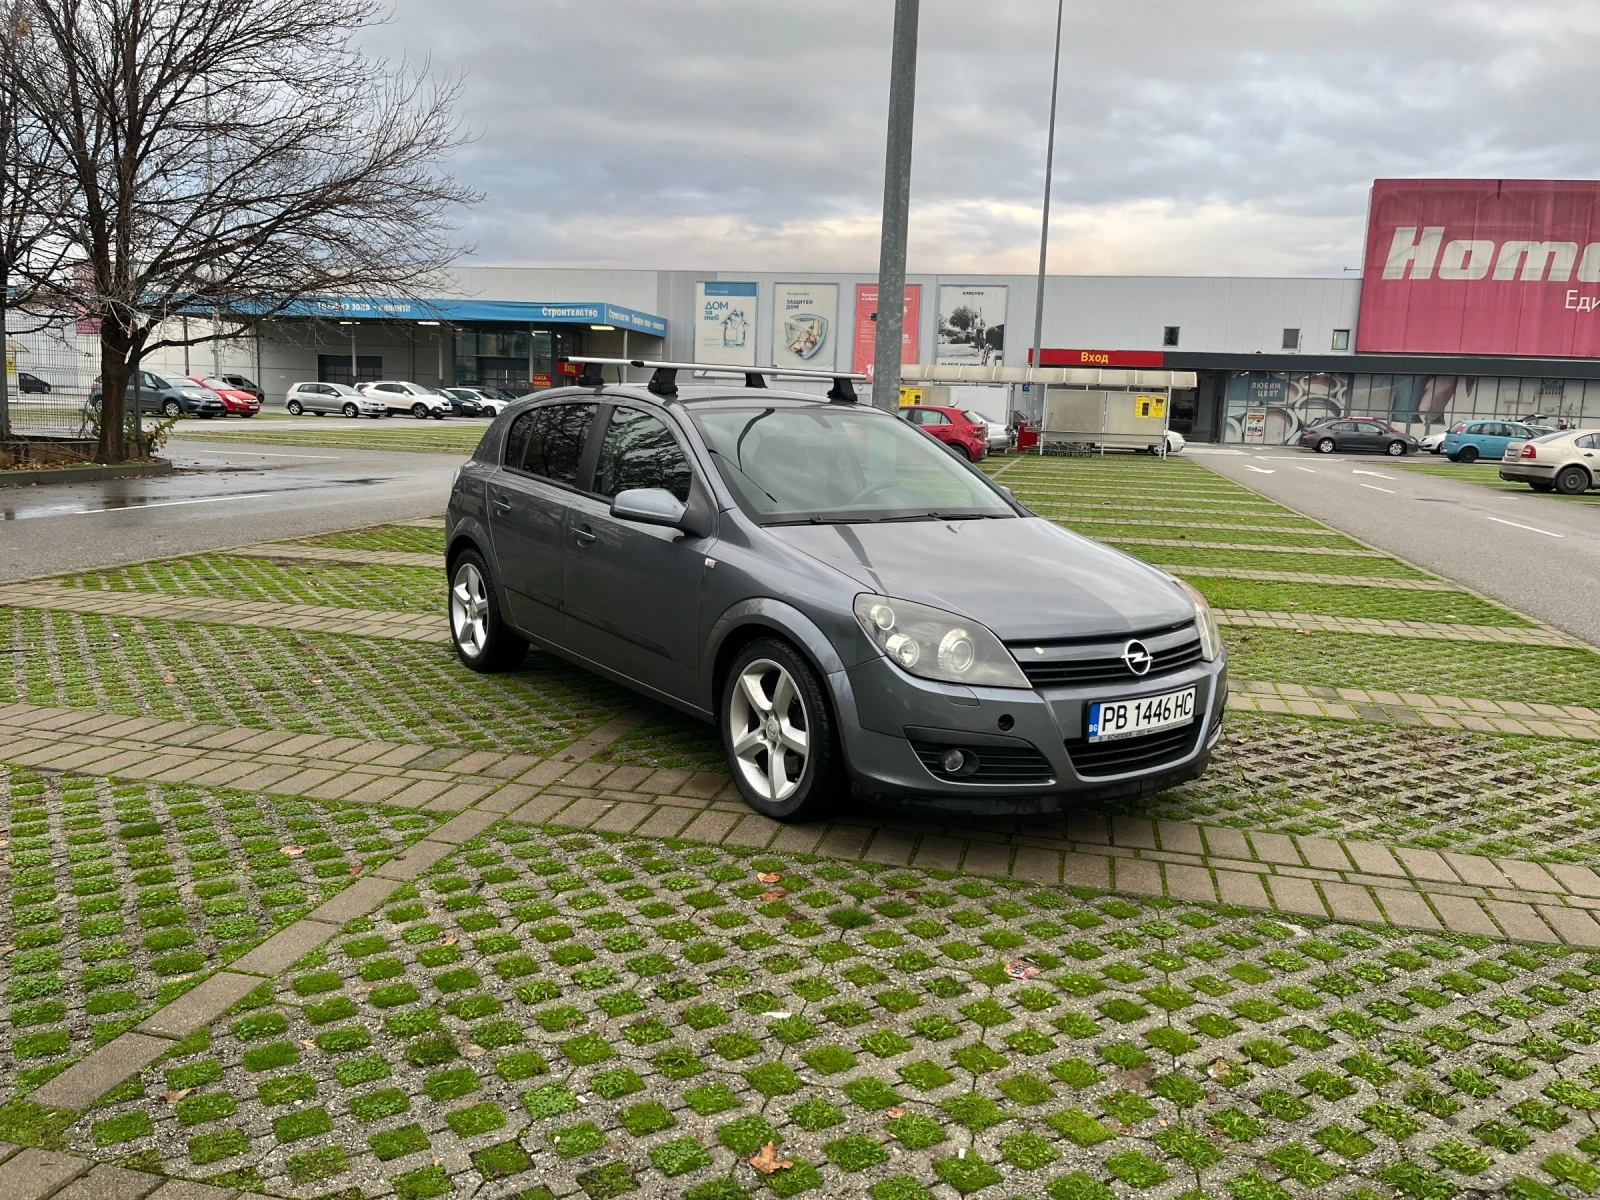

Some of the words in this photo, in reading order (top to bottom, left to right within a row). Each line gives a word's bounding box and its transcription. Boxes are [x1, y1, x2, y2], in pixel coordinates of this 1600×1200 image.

[704, 301, 729, 310] ДОМ
[1565, 290, 1600, 313] Еди
[542, 306, 598, 318] Строителство
[1081, 352, 1109, 364] Вход
[1251, 382, 1281, 390] ЛЮБИМ
[1257, 390, 1279, 398] ЦВЯТ
[1102, 705, 1127, 732] PB
[1135, 697, 1171, 726] 1446
[1174, 692, 1193, 718] HC
[1088, 724, 1098, 732] BG
